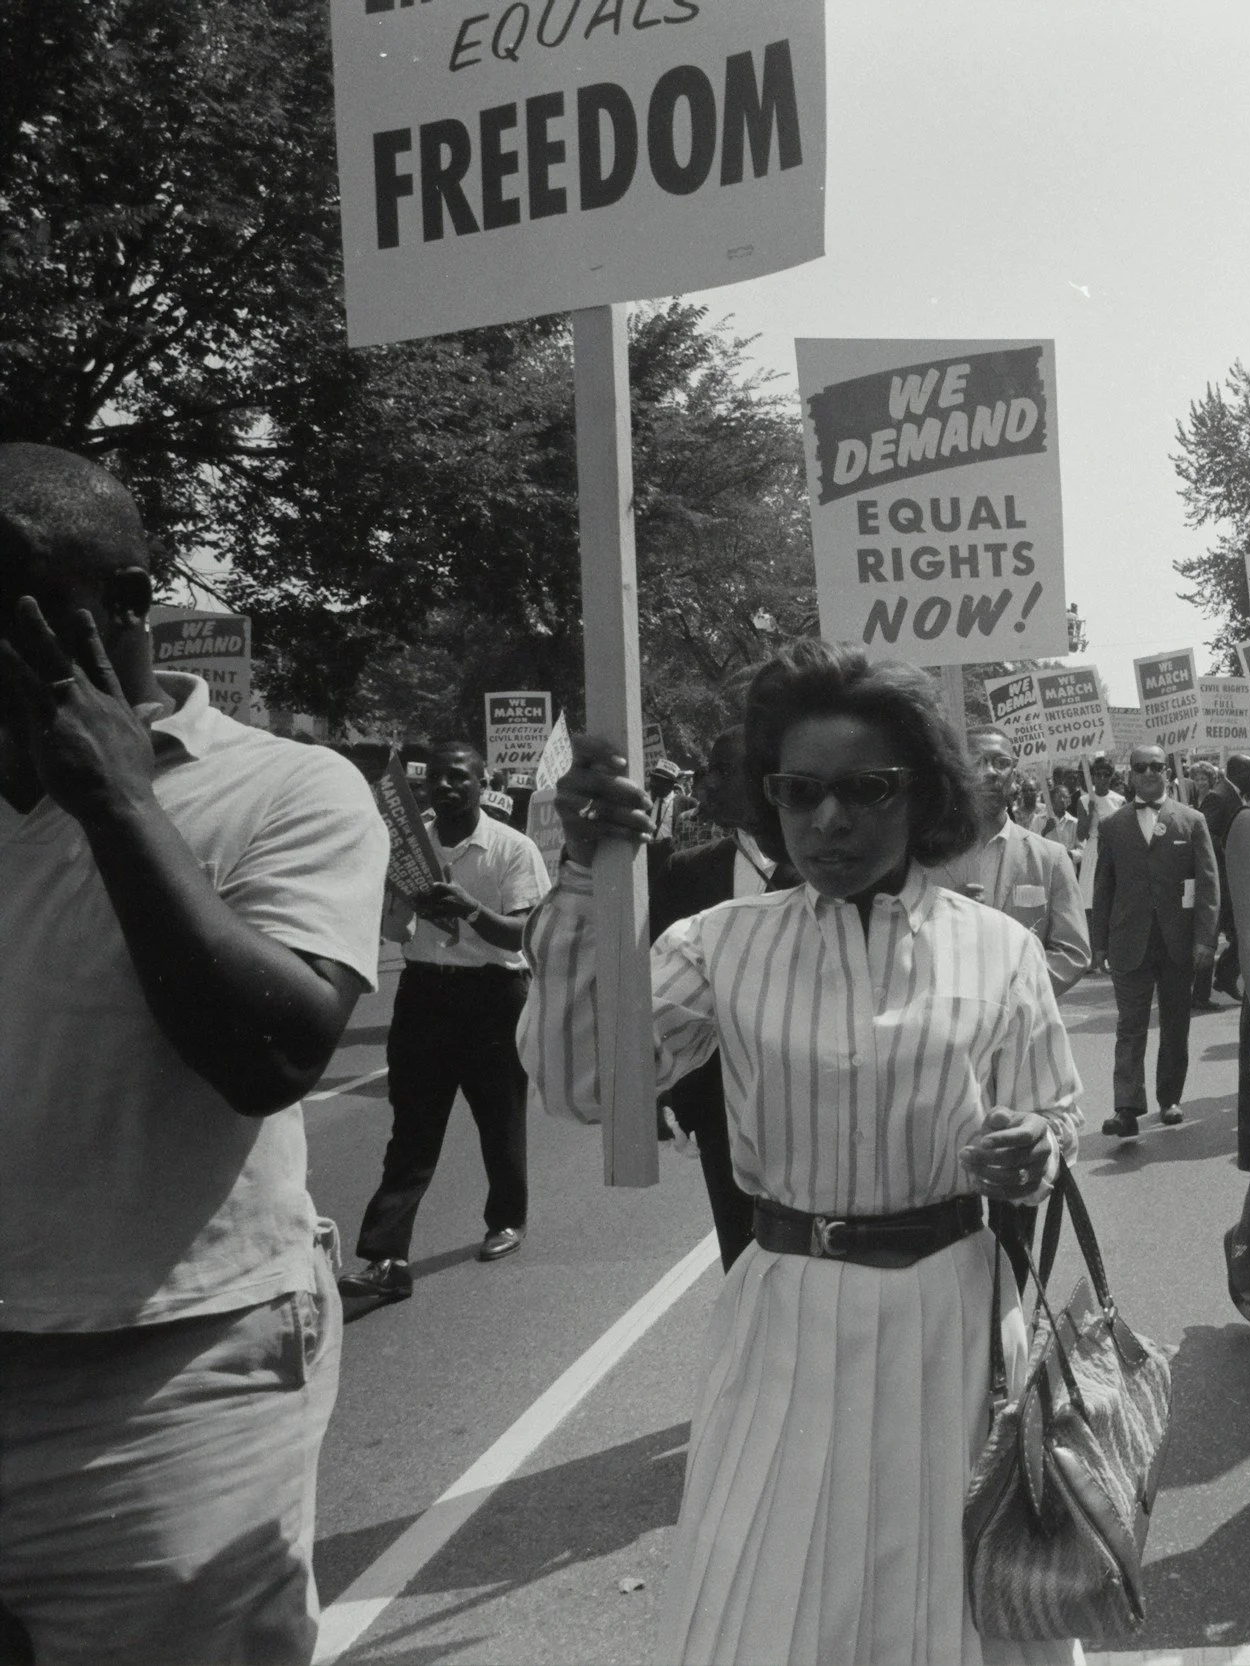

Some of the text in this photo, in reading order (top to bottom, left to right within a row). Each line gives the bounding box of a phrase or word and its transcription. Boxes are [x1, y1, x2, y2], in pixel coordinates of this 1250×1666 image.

[373, 38, 803, 250] FREEDOM
[888, 363, 970, 421] WE
[833, 397, 1038, 485] DEMAND
[857, 494, 1027, 536] EQUAL
[857, 540, 1035, 584] RIGHTS
[862, 581, 1043, 645] NOW!
[182, 621, 216, 638] WE
[159, 635, 242, 660] DEMAND
[1158, 660, 1173, 673] WE
[1008, 678, 1030, 697] WE
[1058, 675, 1076, 686] WE
[1146, 669, 1189, 690] MARCH
[1200, 684, 1220, 693] CIVIL
[1222, 684, 1249, 693] RIGHTS
[1045, 682, 1093, 700] MARCH
[1161, 685, 1178, 695] FOR
[508, 698, 526, 707] WE
[1145, 700, 1170, 716] FIRST
[1171, 694, 1197, 709] CLASS
[1214, 700, 1234, 709] FULL
[494, 707, 542, 718] MARCH
[1004, 715, 1021, 727] AN
[1044, 704, 1102, 721] INTEGRATED
[1145, 706, 1199, 729] CITIZENSHIP
[495, 726, 544, 734] EFFECTIVE
[1015, 723, 1043, 736] POLICE
[1048, 717, 1104, 735] SCHOOLS
[1156, 722, 1198, 747] NOW!
[504, 742, 532, 750] LAWS
[1056, 729, 1105, 753] NOW!
[495, 751, 544, 764] NOW!
[380, 774, 410, 827] MARCH
